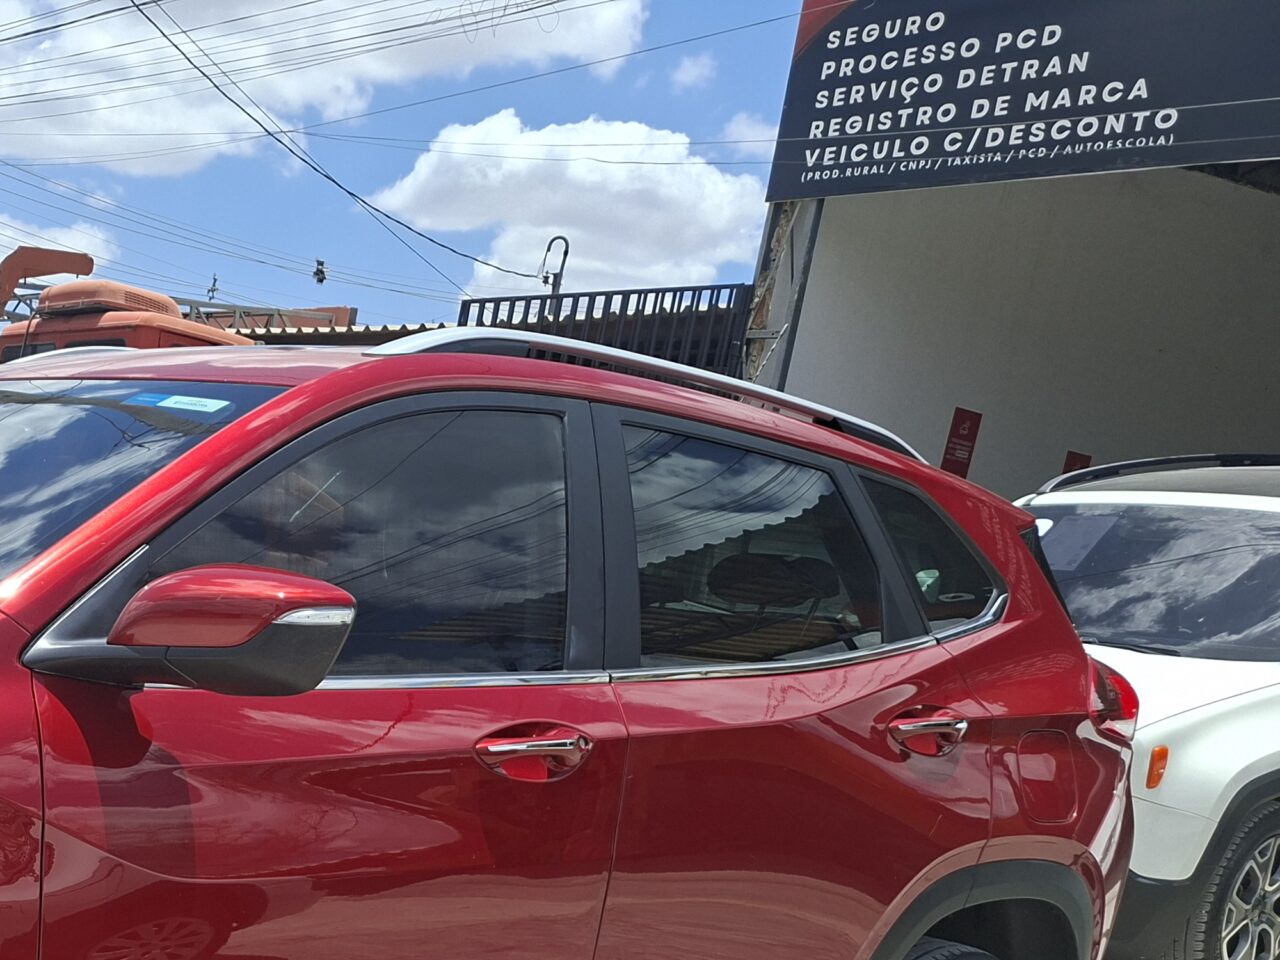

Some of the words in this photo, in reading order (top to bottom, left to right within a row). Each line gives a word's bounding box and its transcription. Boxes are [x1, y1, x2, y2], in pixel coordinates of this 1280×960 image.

[820, 37, 981, 81] PROCESSO
[995, 24, 1063, 54] PCD
[826, 11, 946, 49] SEGURO
[815, 73, 944, 109] SERVIÇO
[957, 51, 1090, 90] DETRAN
[805, 136, 930, 168] VEICULO
[943, 107, 1179, 153] C/DESCONTO
[809, 103, 957, 140] REGISTRO
[970, 95, 1011, 120] DE
[1024, 78, 1149, 113] MARCA
[801, 162, 885, 183] (PROD.RURAL
[899, 160, 932, 172] CNPJ
[947, 151, 1002, 167] TAXISTA
[1018, 147, 1047, 160] PCD
[1063, 133, 1175, 155] AUTOESCOLA)
